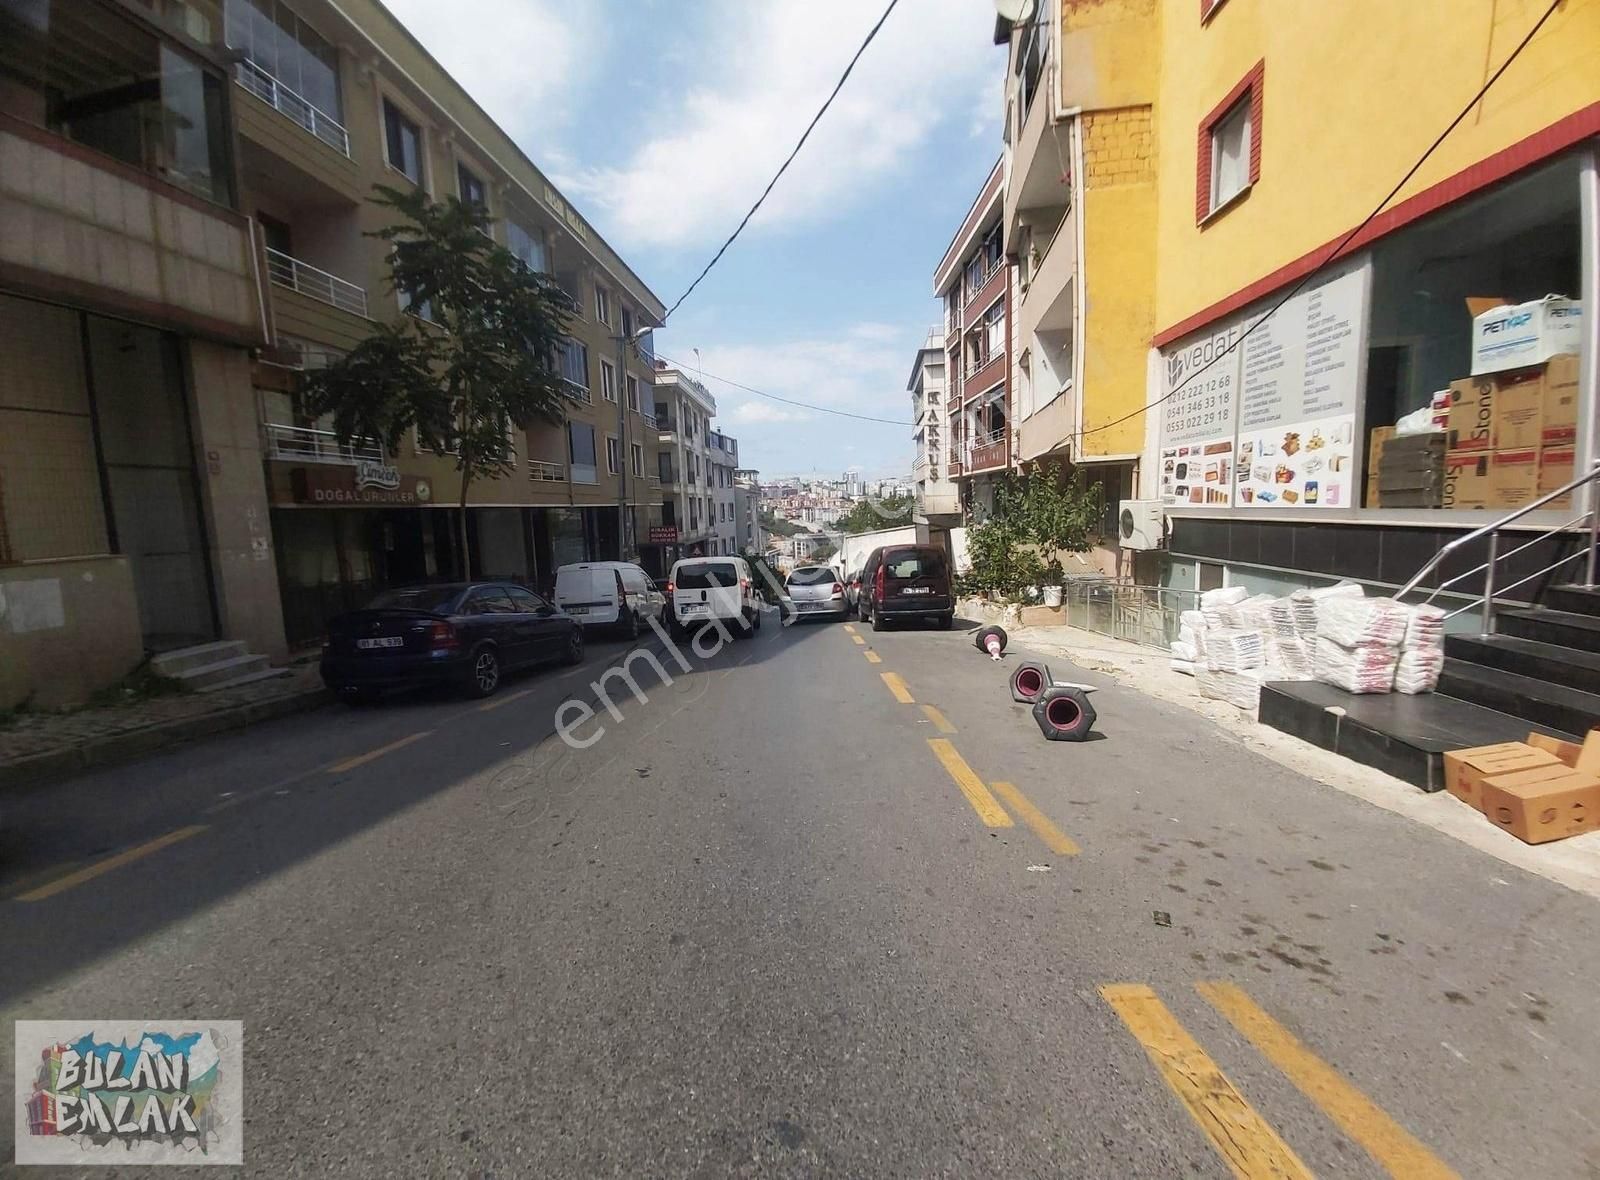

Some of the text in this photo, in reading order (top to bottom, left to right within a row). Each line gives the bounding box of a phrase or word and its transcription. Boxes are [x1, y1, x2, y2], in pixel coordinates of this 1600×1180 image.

[1184, 329, 1237, 370] vedat
[1188, 385, 1203, 398] 222
[1206, 380, 1216, 392] 12
[1220, 375, 1230, 387] 68
[1186, 416, 1202, 428] 022
[1204, 412, 1215, 425] 29
[1218, 408, 1229, 421] 18
[1187, 401, 1202, 414] 346
[1204, 396, 1215, 409] 33
[1219, 392, 1230, 404] 18
[1471, 383, 1492, 440] Stone
[1444, 465, 1464, 509] Ston
